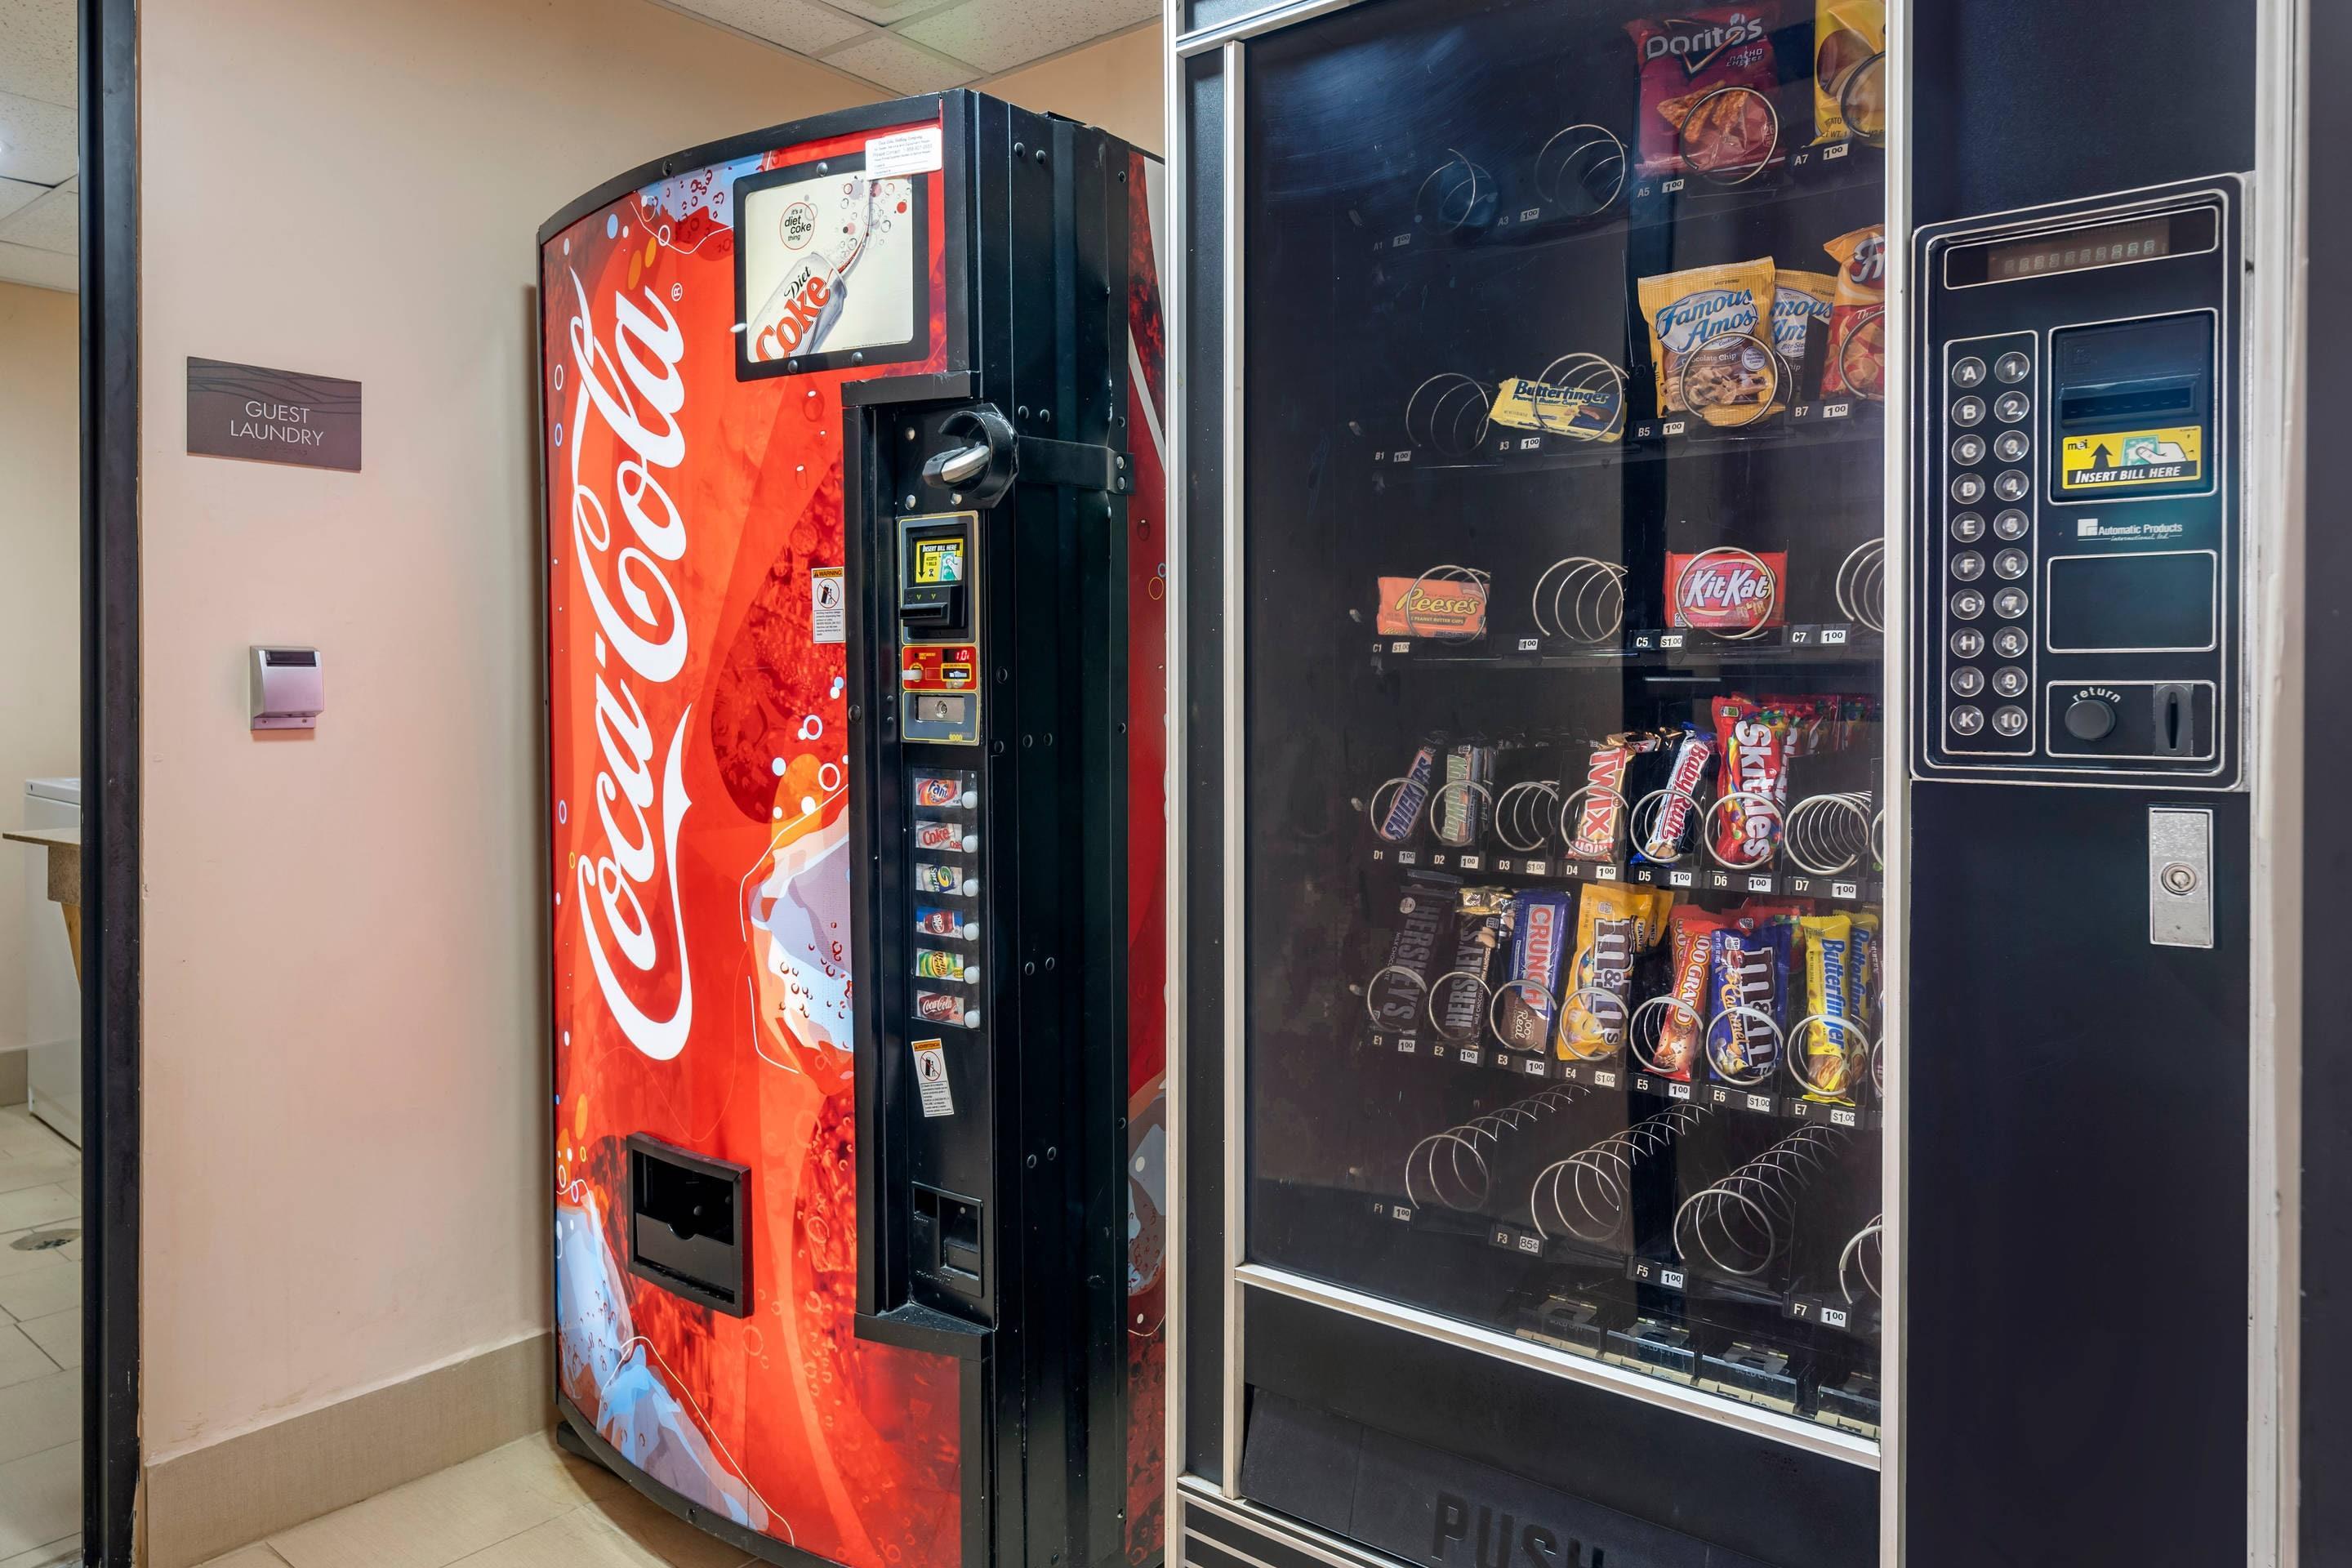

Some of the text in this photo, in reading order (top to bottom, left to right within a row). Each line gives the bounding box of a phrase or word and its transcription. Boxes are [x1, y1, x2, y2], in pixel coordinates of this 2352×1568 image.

[1647, 17, 1762, 60] Doritos
[1794, 154, 1809, 166] A7
[1637, 187, 1650, 198] A5
[785, 215, 802, 227] diet
[1498, 216, 1508, 227] A3
[791, 223, 812, 234] coke
[788, 234, 800, 242] thing
[1373, 241, 1383, 251] A1
[784, 265, 811, 298] Diet
[755, 277, 831, 362] Coke
[1656, 288, 1753, 340] Famous
[1677, 310, 1758, 353] Amos
[1718, 353, 1736, 362] Chip
[1963, 366, 1976, 381] A
[2007, 362, 2016, 376] 1
[1513, 380, 1610, 403] Butterfinger
[245, 401, 310, 424] GUEST
[1795, 406, 1809, 416] B7
[1963, 404, 1976, 419] B
[2007, 400, 2018, 415] 2
[230, 419, 324, 446] LAUNDRY
[1638, 426, 1650, 437] B5
[1963, 443, 1976, 458] C
[2007, 439, 2018, 454] 3
[2068, 439, 2088, 450] mei
[1374, 451, 1384, 461] B1
[2075, 466, 2181, 483] INSERT BILL HERE
[1963, 482, 1976, 497] D
[2007, 479, 2018, 492] 4
[1963, 520, 1976, 535] E
[2007, 518, 2018, 532] 5
[2099, 523, 2182, 536] Automatic Products
[1963, 559, 1976, 573] F
[2006, 557, 2017, 572] 6
[1962, 597, 1976, 612] G
[2007, 596, 2018, 611] 7
[1636, 637, 1649, 647] C5
[1792, 632, 1806, 643] C7
[1962, 635, 1976, 650] H
[2006, 635, 2017, 650] 8
[1373, 644, 1382, 653] C1
[570, 268, 692, 1062] Coca-Cola
[1963, 675, 1974, 689] J
[2006, 675, 2017, 689] 9
[2072, 687, 2121, 703] return
[1962, 713, 1975, 728] K
[2002, 714, 2021, 728] 10
[1735, 720, 1775, 857] Skittles
[923, 828, 950, 846] Coke
[1374, 850, 1383, 860] D1
[1434, 855, 1445, 865] D2
[1499, 860, 1510, 870] D3
[1566, 865, 1578, 875] D4
[1638, 871, 1650, 881] D5
[1714, 875, 1727, 886] D6
[1795, 880, 1810, 891] D7
[1525, 907, 1552, 1009] CRUNCH
[1515, 1010, 1529, 1040] Real
[1374, 1036, 1382, 1045] E1
[1434, 1046, 1444, 1056] E2
[1498, 1054, 1508, 1065] E3
[1566, 1067, 1576, 1078] E4
[1637, 1079, 1648, 1090] E5
[1713, 1089, 1726, 1102] E6
[1795, 1104, 1807, 1116] E7
[1374, 1203, 1383, 1214] F1
[1497, 1232, 1538, 1250] F3 85¢
[1637, 1264, 1649, 1278] F5
[1793, 1303, 1807, 1316] F7
